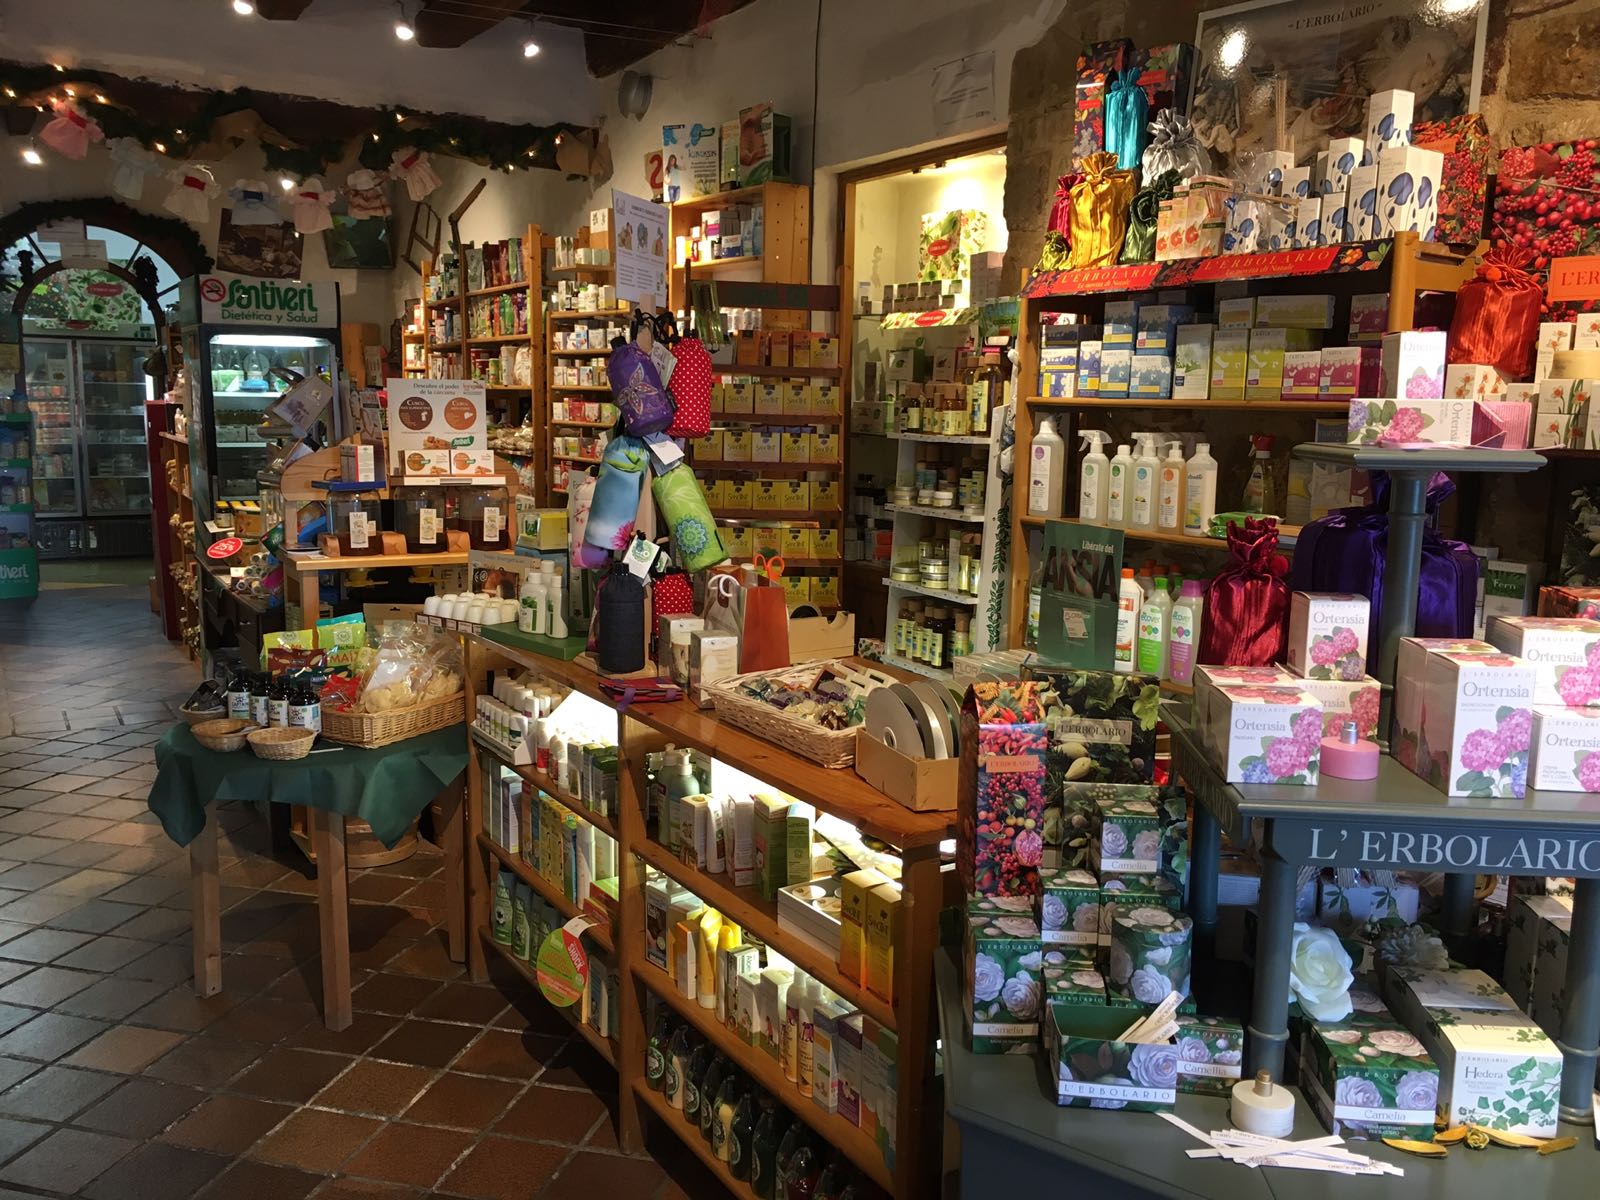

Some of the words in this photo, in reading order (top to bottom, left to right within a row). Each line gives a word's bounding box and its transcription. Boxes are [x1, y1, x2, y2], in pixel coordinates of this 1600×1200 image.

[1205, 251, 1330, 270] L'ERBOLARIO
[1061, 269, 1158, 284] L'ERBOLARIO
[222, 280, 318, 312] Santiveri
[222, 309, 272, 320] Dietética
[276, 314, 284, 324] y
[287, 311, 318, 323] Salud
[1312, 612, 1365, 625] Ortensia
[1527, 648, 1584, 663] Ortensia
[1462, 681, 1530, 698] Ortensia
[1060, 725, 1127, 737] L'ERBOLARIO
[1234, 718, 1286, 732] Ortensia
[1110, 860, 1148, 871] Camelia
[1051, 933, 1088, 943] Camelia
[567, 943, 585, 972] SHOCK
[986, 1024, 1024, 1034] Camelia
[1464, 1066, 1504, 1079] Hedera
[1063, 1083, 1171, 1100] L'ERBOLARIO
[1364, 1110, 1407, 1121] Camelia
